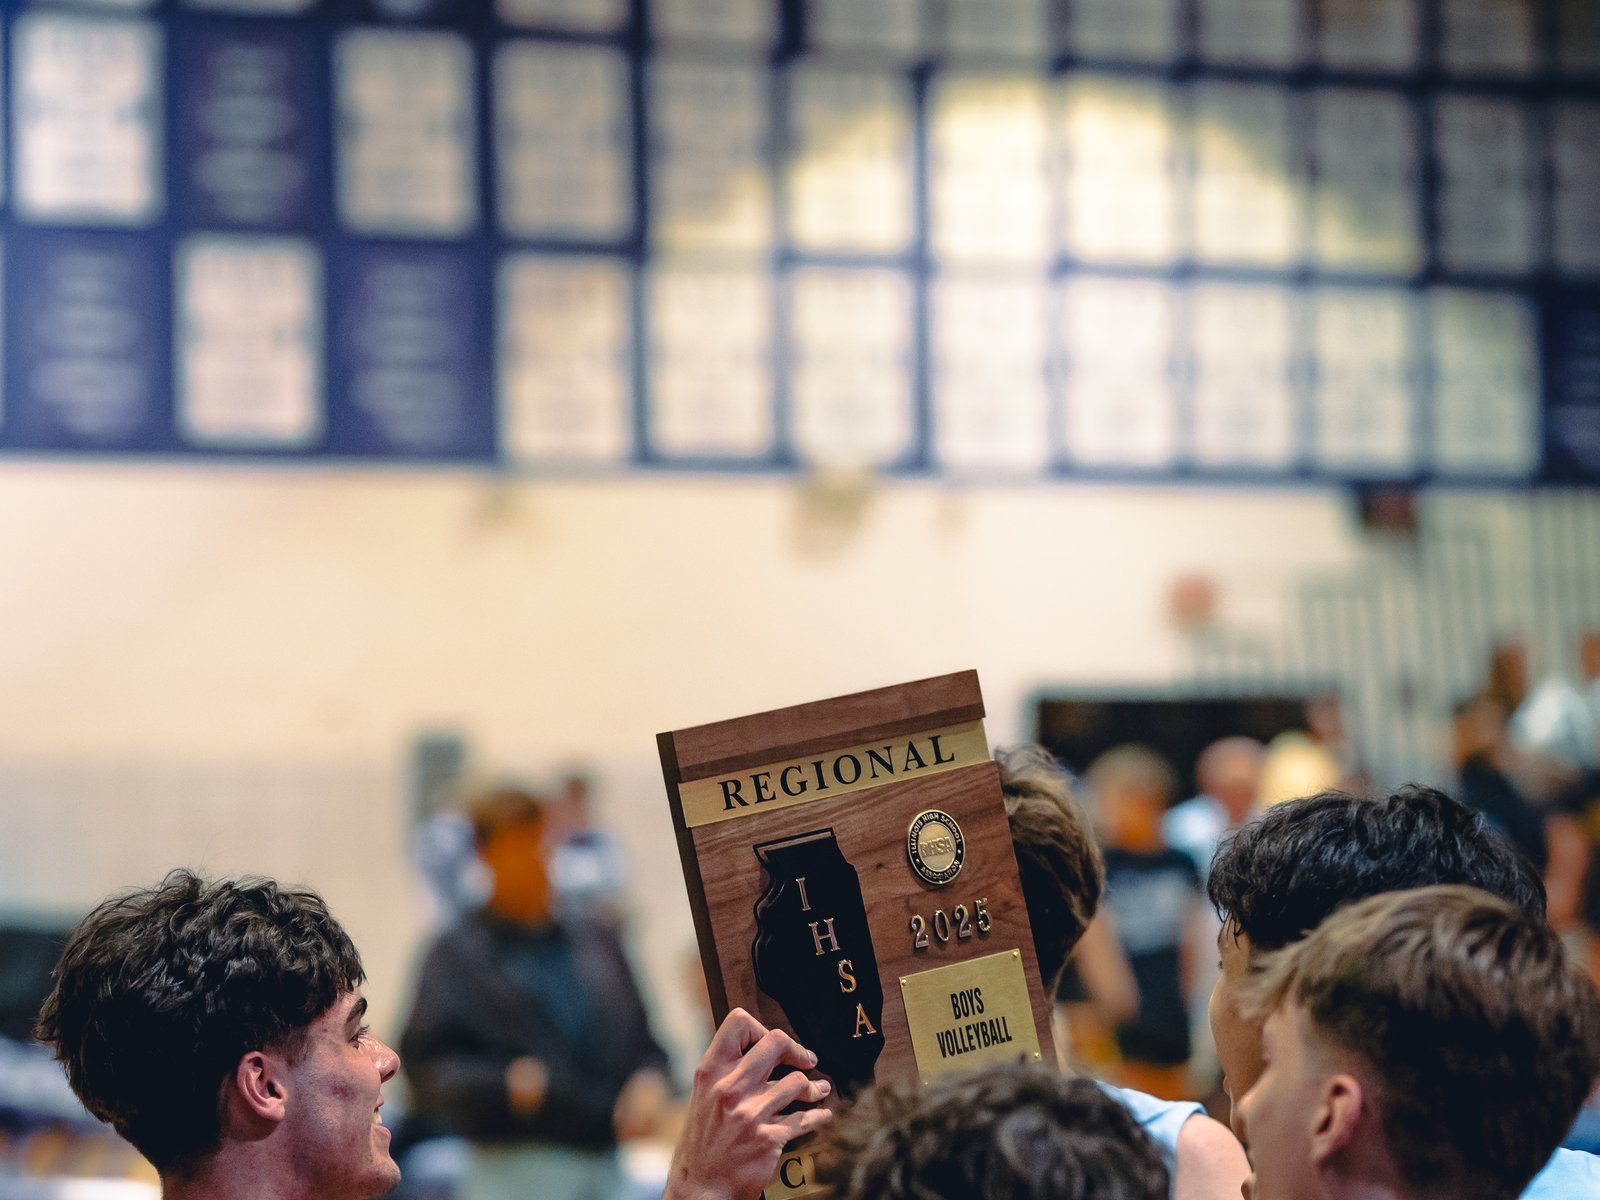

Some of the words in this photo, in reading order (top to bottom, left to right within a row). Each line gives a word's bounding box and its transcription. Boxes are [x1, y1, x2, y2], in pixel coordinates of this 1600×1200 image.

[717, 735, 955, 811] REGIONAL
[911, 820, 923, 853] ILLINOIS
[922, 812, 939, 822] HIGH
[940, 815, 961, 843] SCHOOL
[921, 859, 960, 879] ASSOCIATION
[911, 898, 991, 948] 2025
[950, 987, 985, 1020] BOYS
[936, 1016, 1013, 1059] VOLLEYBALL
